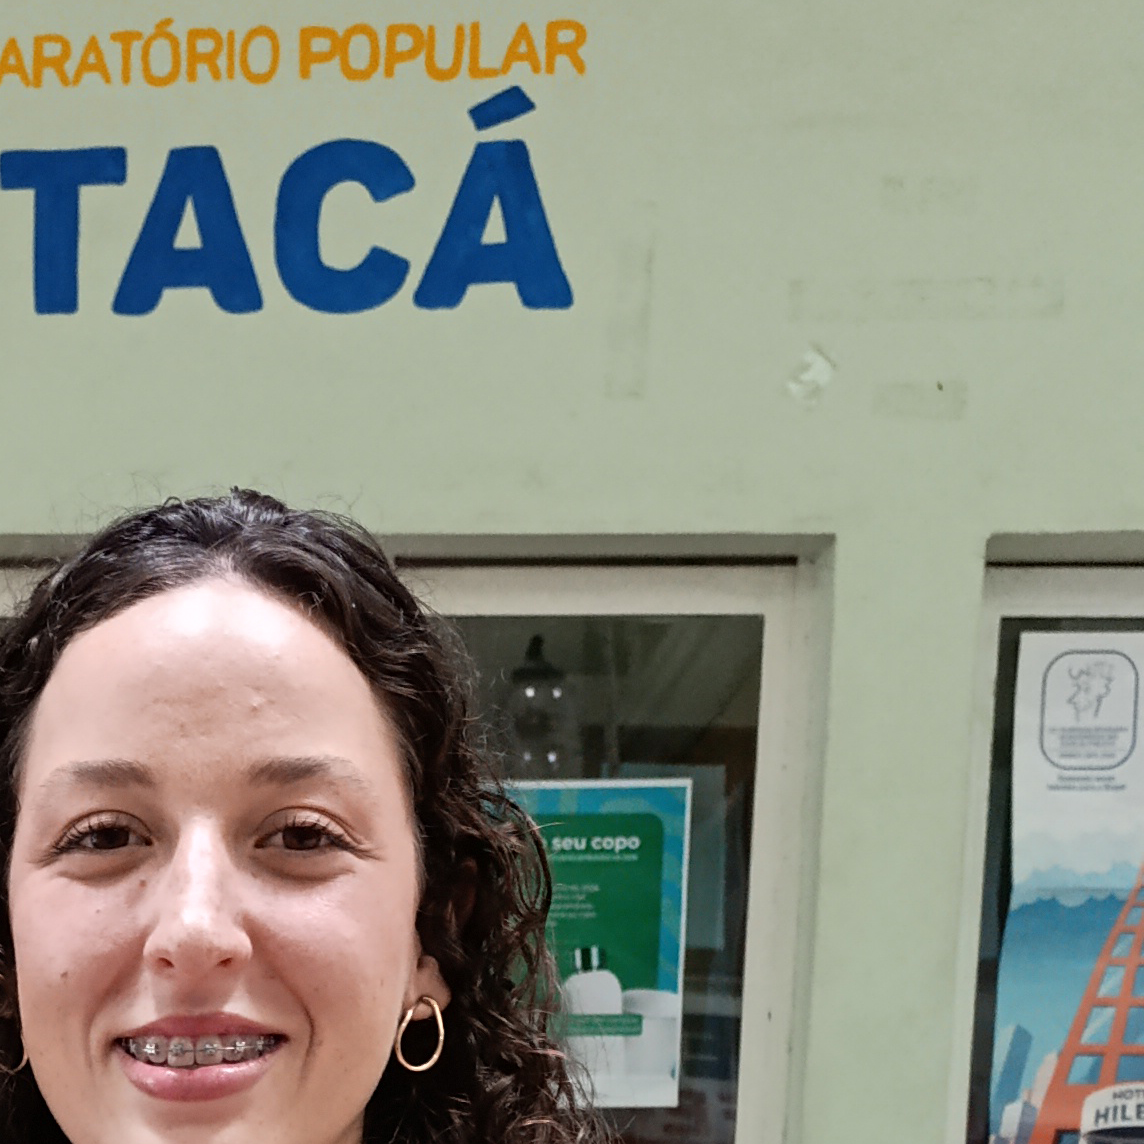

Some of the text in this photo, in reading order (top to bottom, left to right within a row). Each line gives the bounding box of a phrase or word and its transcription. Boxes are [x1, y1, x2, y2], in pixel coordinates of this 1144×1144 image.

[298, 19, 586, 83] POPULAR
[551, 836, 641, 853] seu copo
